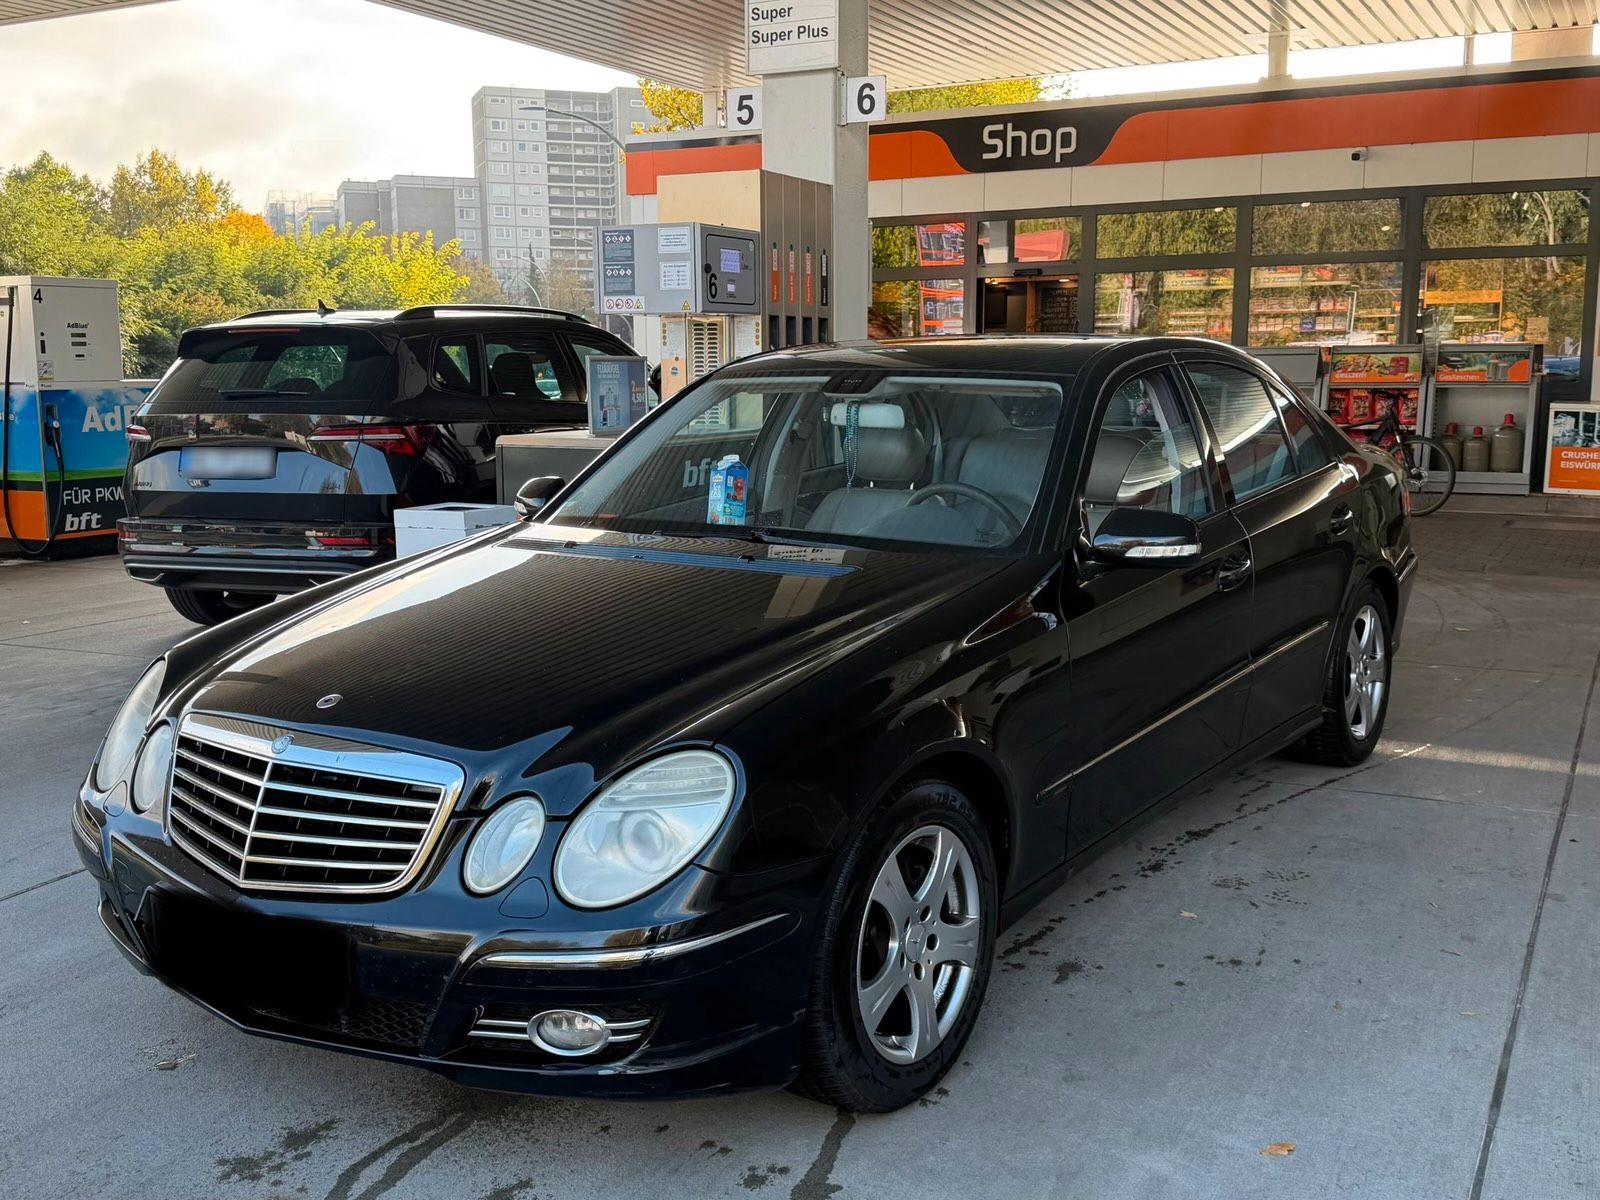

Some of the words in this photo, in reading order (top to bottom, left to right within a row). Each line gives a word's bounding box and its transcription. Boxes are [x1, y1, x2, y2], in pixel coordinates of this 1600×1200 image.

[751, 7, 793, 22] Super
[751, 30, 793, 45] Super
[797, 25, 829, 39] Plus
[857, 83, 876, 115] 6
[736, 94, 754, 125] 5
[982, 122, 1077, 163] Shop
[709, 273, 718, 299] 6
[34, 289, 43, 304] 4
[63, 487, 91, 505] FÜR
[65, 512, 102, 531] bft
